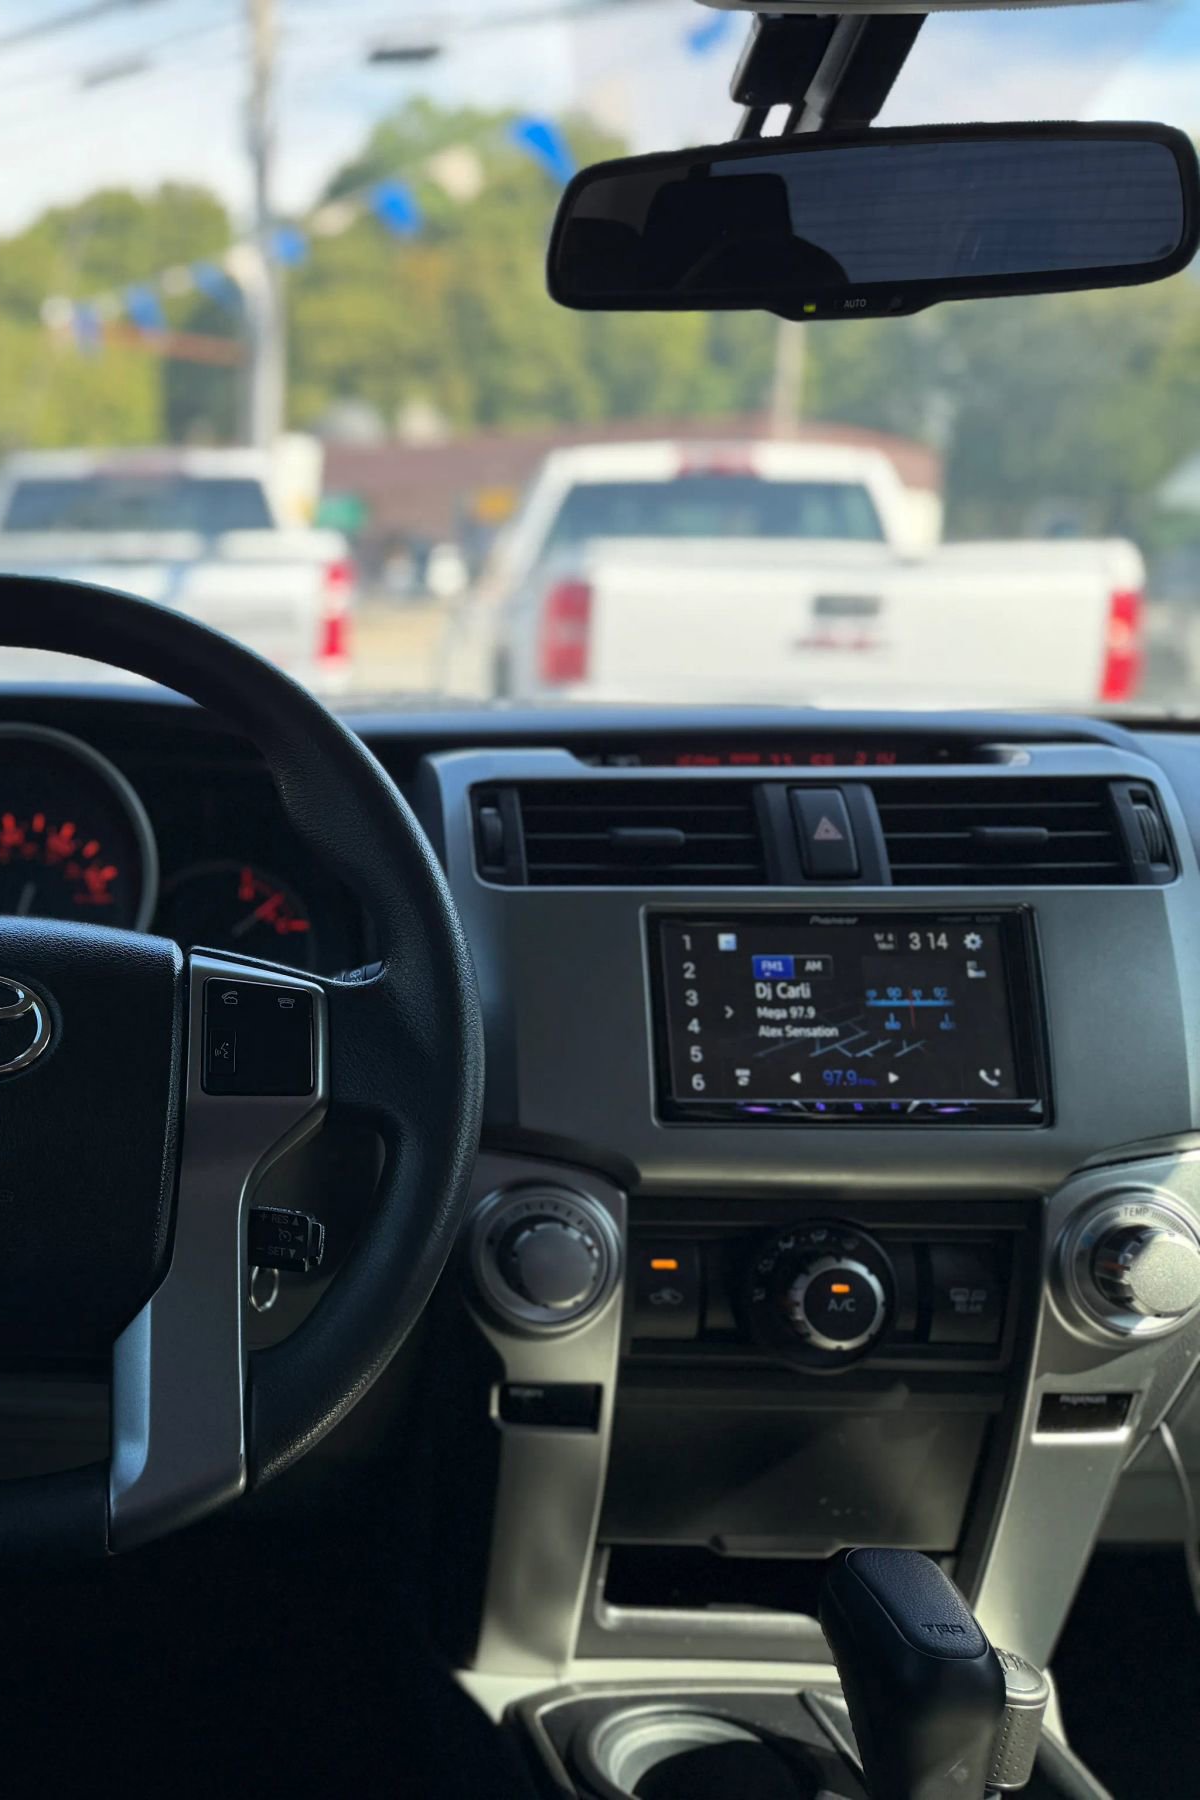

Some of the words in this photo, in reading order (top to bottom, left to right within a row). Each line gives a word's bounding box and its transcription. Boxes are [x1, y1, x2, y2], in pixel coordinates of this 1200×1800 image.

[843, 299, 867, 309] AUTO
[681, 934, 692, 951] 1
[682, 962, 696, 979] 2
[804, 960, 824, 972] AM
[685, 989, 699, 1007] 3
[755, 982, 773, 1001] Dj
[776, 982, 811, 999] Carli
[756, 1006, 788, 1020] Mega
[789, 1006, 816, 1019] 97.9
[687, 1017, 701, 1034] 4
[758, 1025, 783, 1037] Alex
[785, 1025, 839, 1037] Sensation
[690, 1045, 703, 1063] 5
[691, 1073, 706, 1091] 6
[1124, 1206, 1150, 1217] TEMP
[267, 1246, 287, 1257] SET
[827, 1298, 857, 1312] A/C
[920, 1623, 966, 1636] TRD
